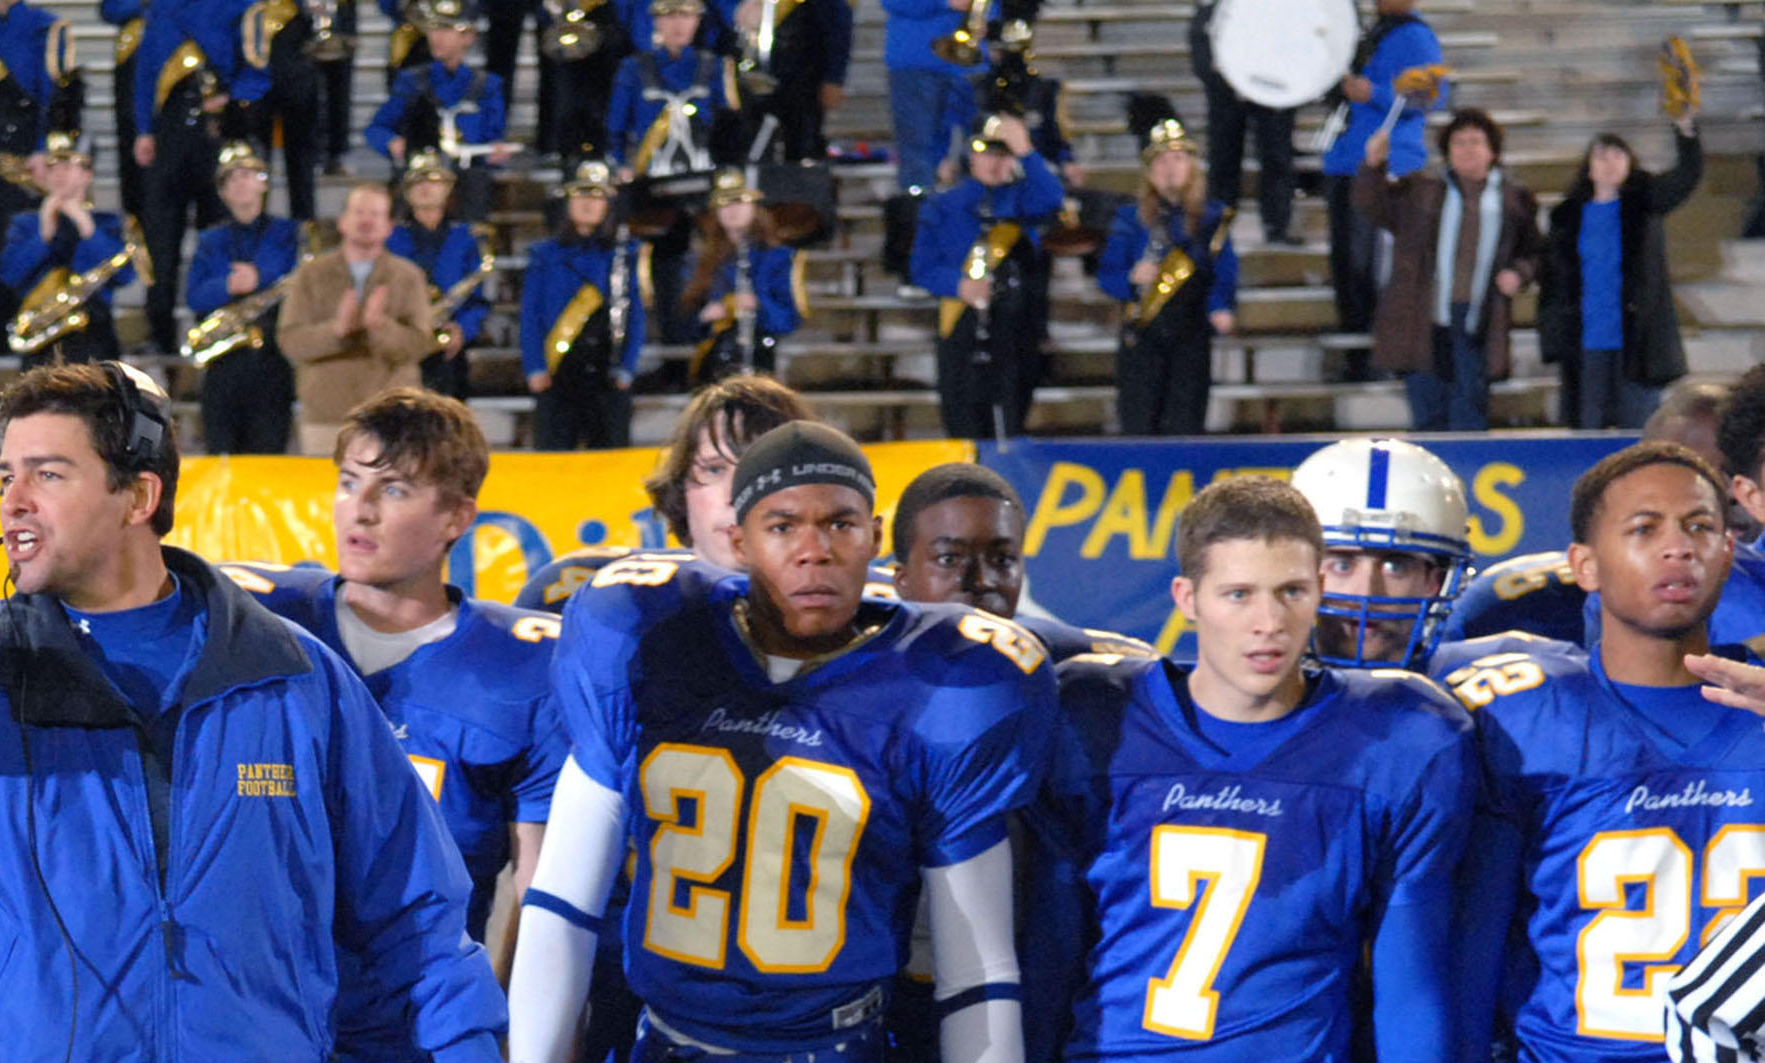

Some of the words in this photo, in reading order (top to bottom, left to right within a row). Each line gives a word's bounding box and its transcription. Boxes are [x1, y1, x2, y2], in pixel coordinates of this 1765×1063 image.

[700, 707, 823, 747] Panthers
[1162, 783, 1283, 816] Panthers
[1624, 779, 1753, 814] Panthers
[639, 742, 872, 973] 20
[1141, 824, 1268, 1041] 7
